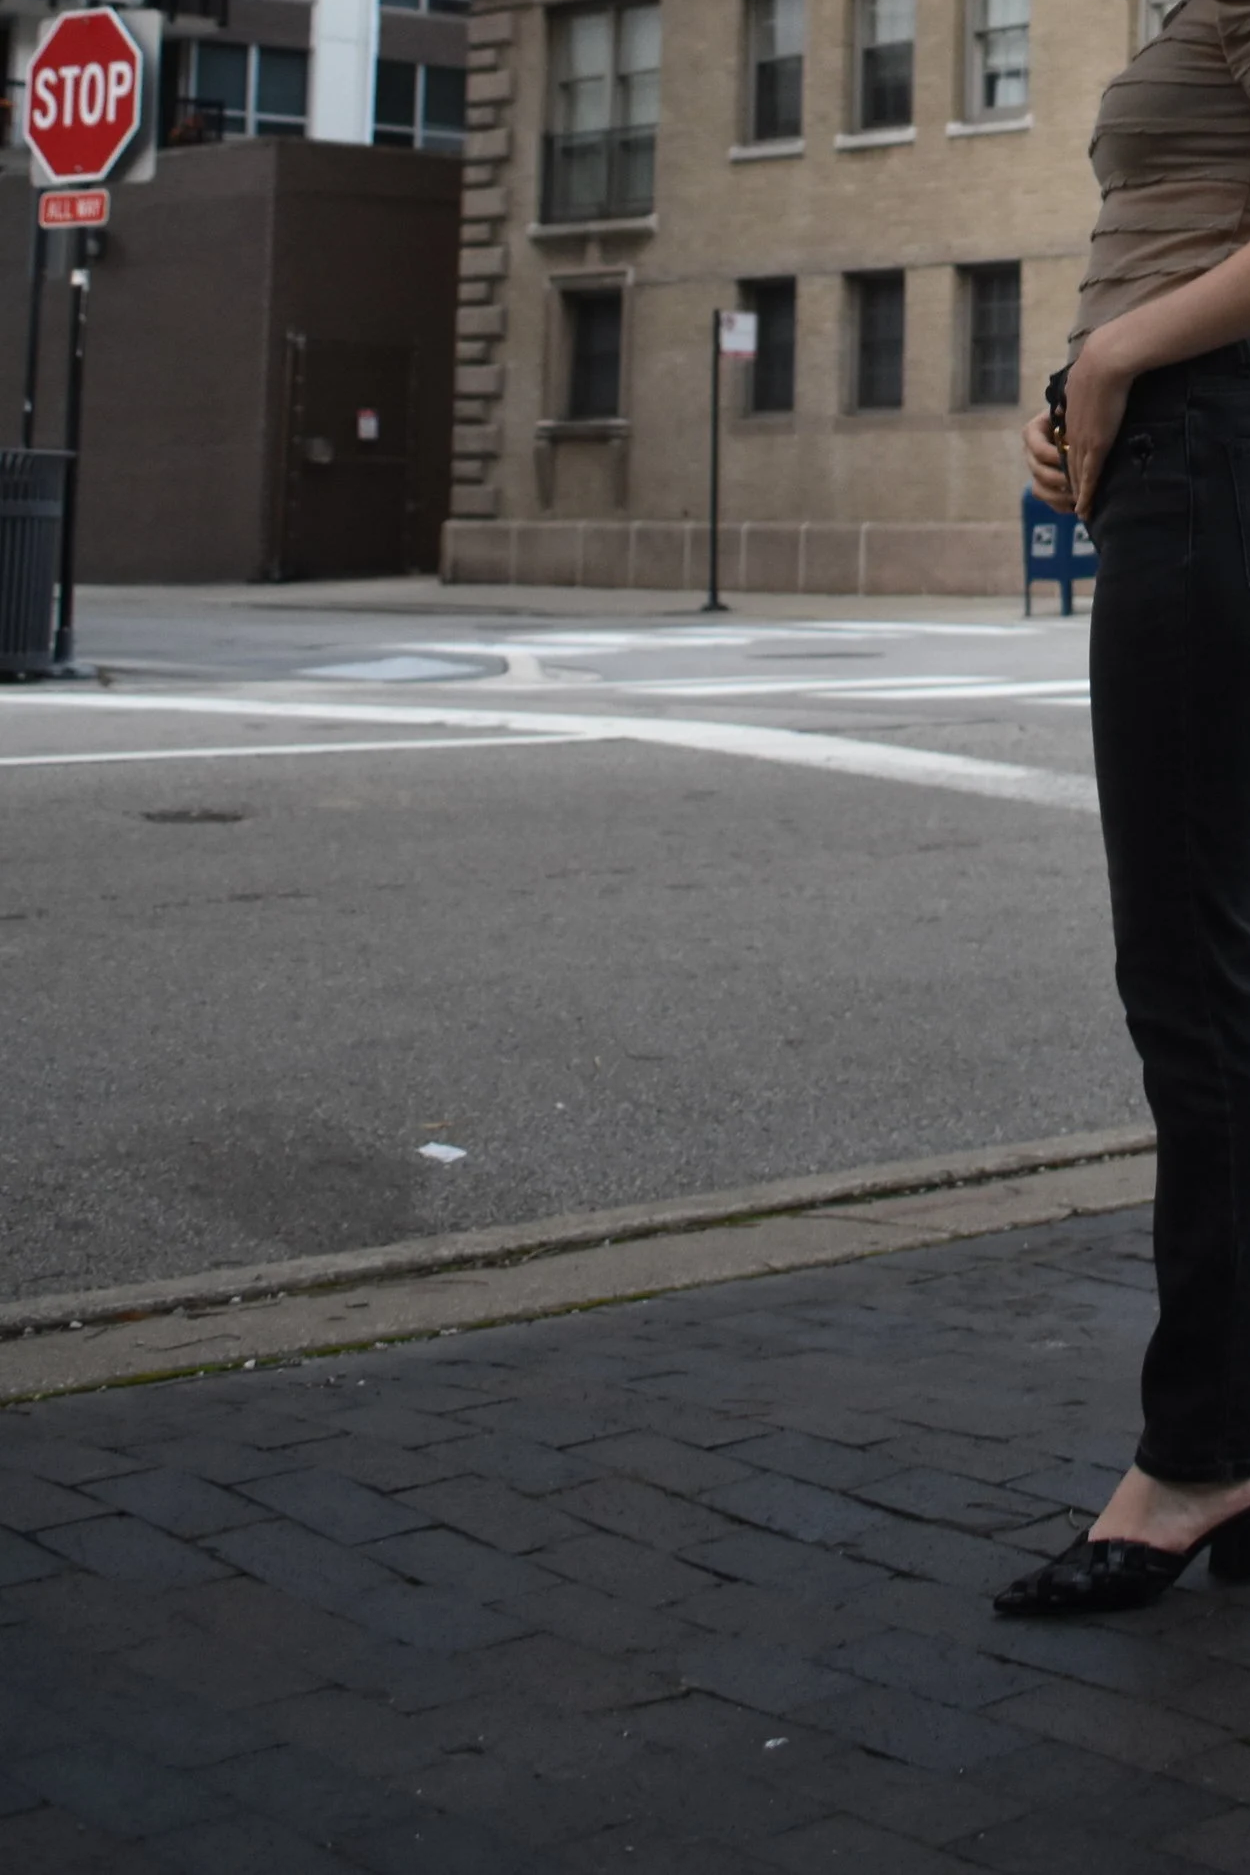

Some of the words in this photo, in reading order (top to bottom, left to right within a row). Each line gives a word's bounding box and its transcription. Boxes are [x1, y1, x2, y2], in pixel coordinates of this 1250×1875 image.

[32, 61, 134, 131] STOP
[46, 199, 71, 221] ALL
[75, 196, 101, 218] WAY
